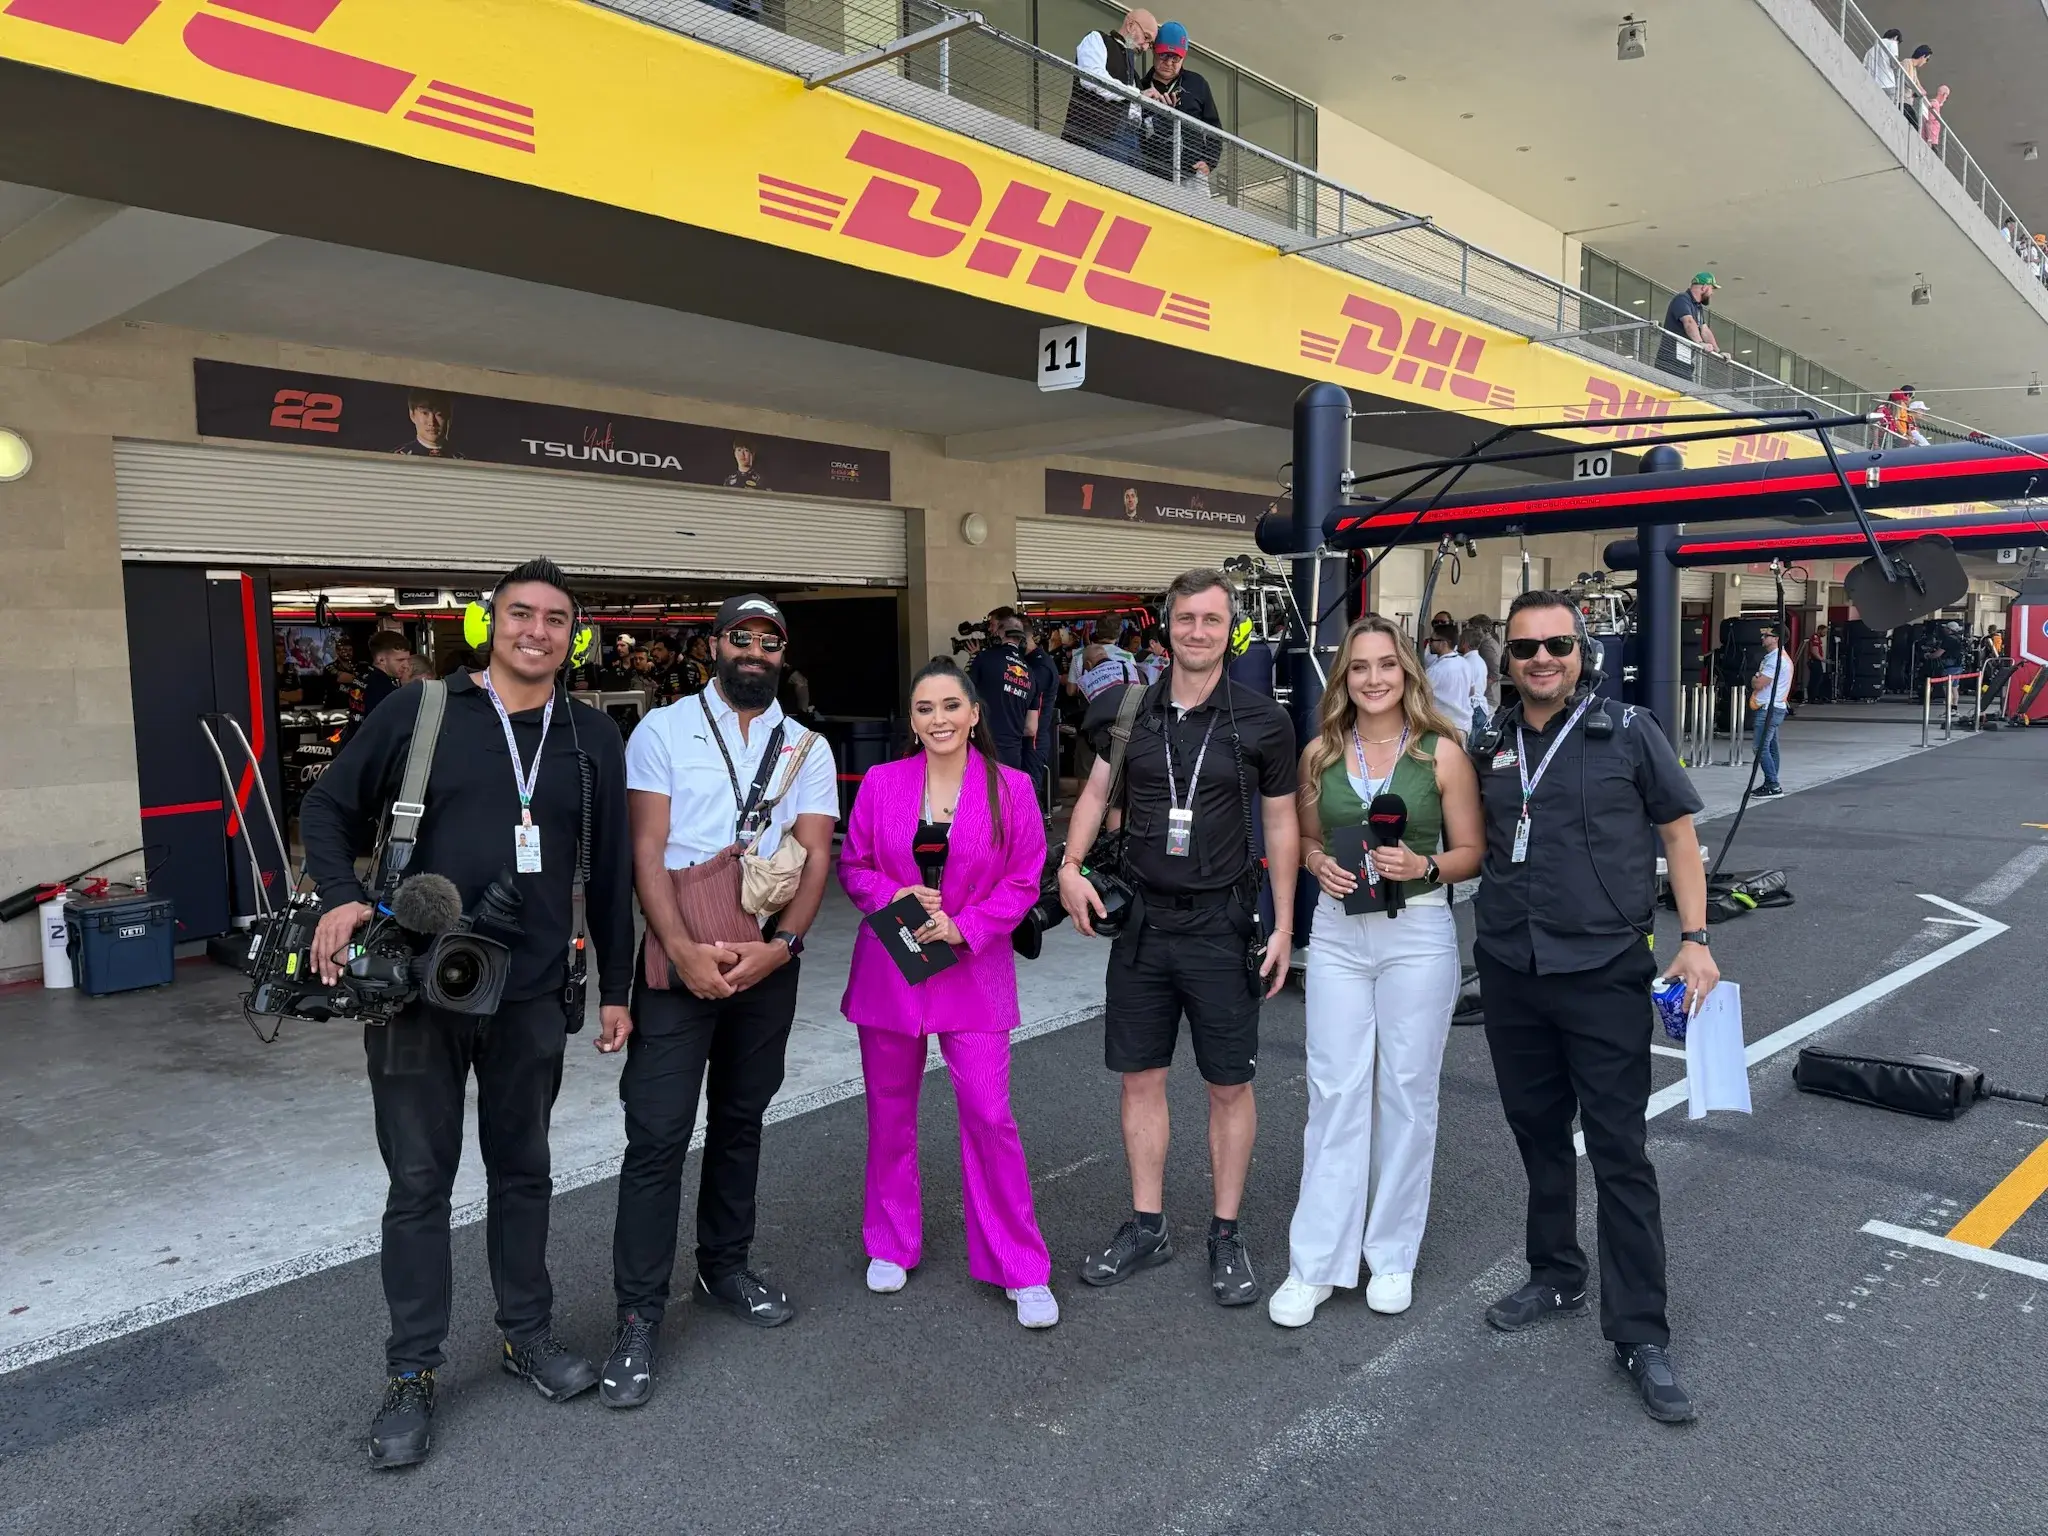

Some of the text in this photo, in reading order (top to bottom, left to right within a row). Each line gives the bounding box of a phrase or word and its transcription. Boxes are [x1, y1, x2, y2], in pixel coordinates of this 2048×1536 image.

[840, 129, 1166, 317] DHL
[1044, 336, 1081, 372] 11
[1334, 293, 1492, 404] DHL
[270, 389, 343, 433] 22
[521, 438, 683, 471] TSUNODA
[830, 461, 859, 471] ORACLE
[1578, 457, 1608, 478] 10
[1081, 484, 1094, 510] 1
[1155, 506, 1246, 524] VERSTAPPEN
[2002, 551, 2011, 559] 8
[402, 590, 435, 599] ORACLE
[1003, 672, 1032, 690] Red Bull
[296, 745, 333, 756] HONDA
[121, 927, 143, 937] YETI
